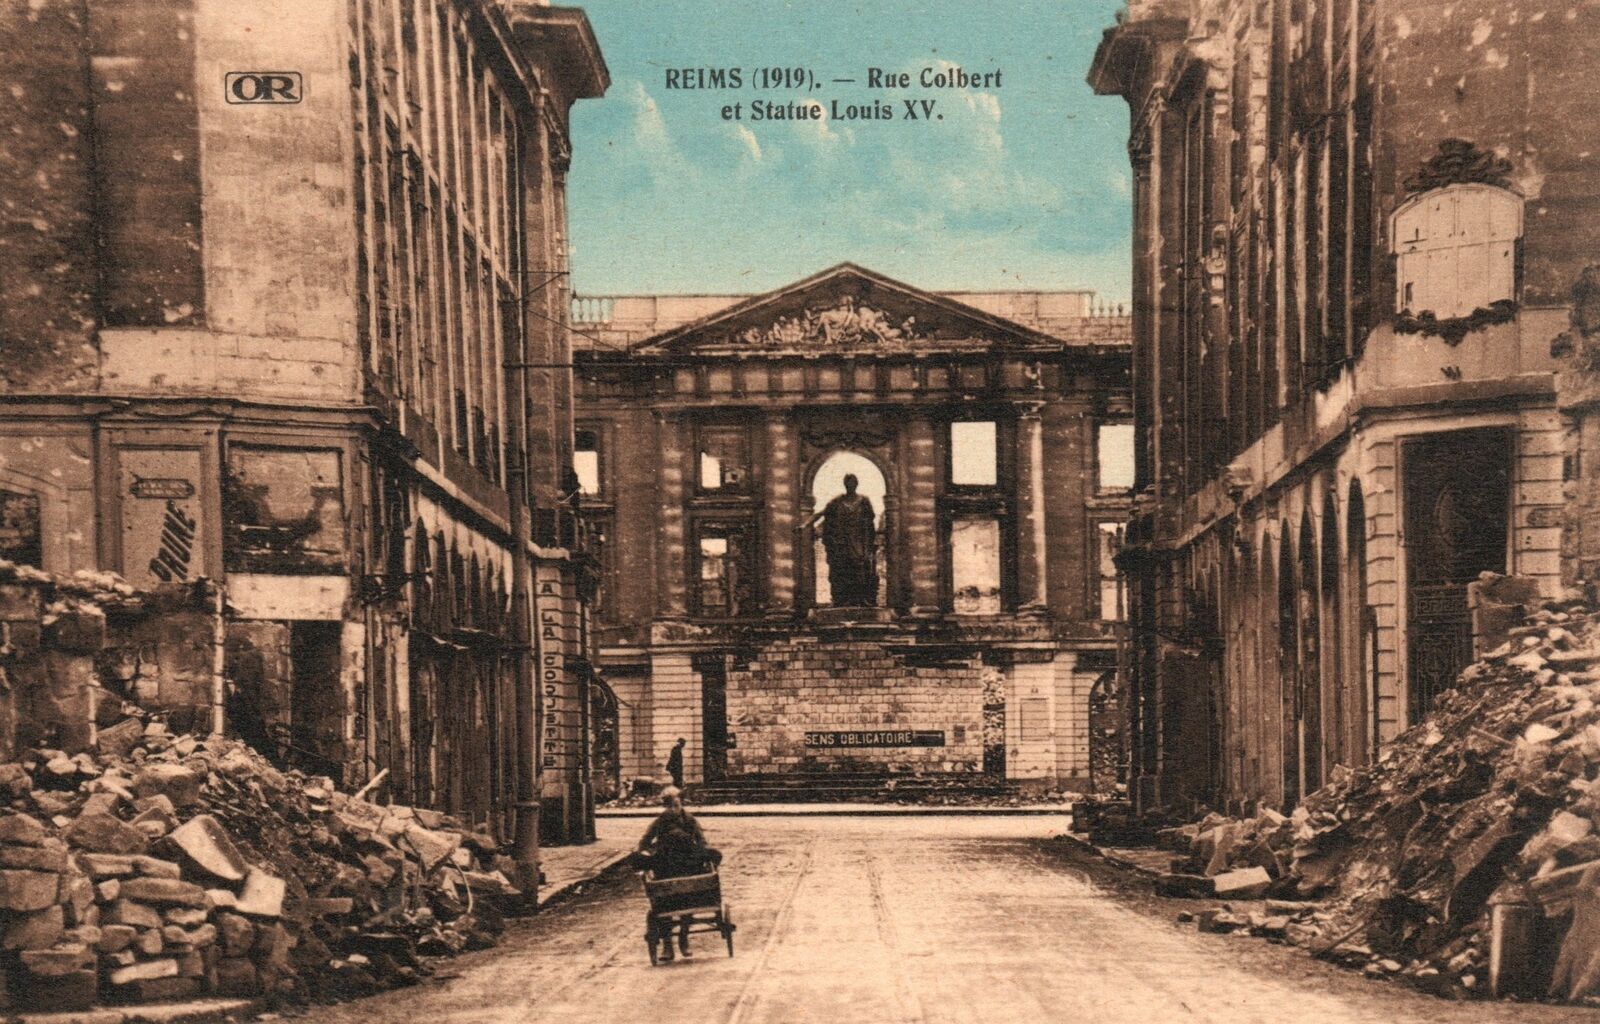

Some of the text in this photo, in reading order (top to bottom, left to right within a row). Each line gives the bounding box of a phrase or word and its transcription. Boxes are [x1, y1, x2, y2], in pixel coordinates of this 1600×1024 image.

[541, 581, 554, 594] A
[541, 610, 556, 637] LA
[805, 733, 835, 746] SENS
